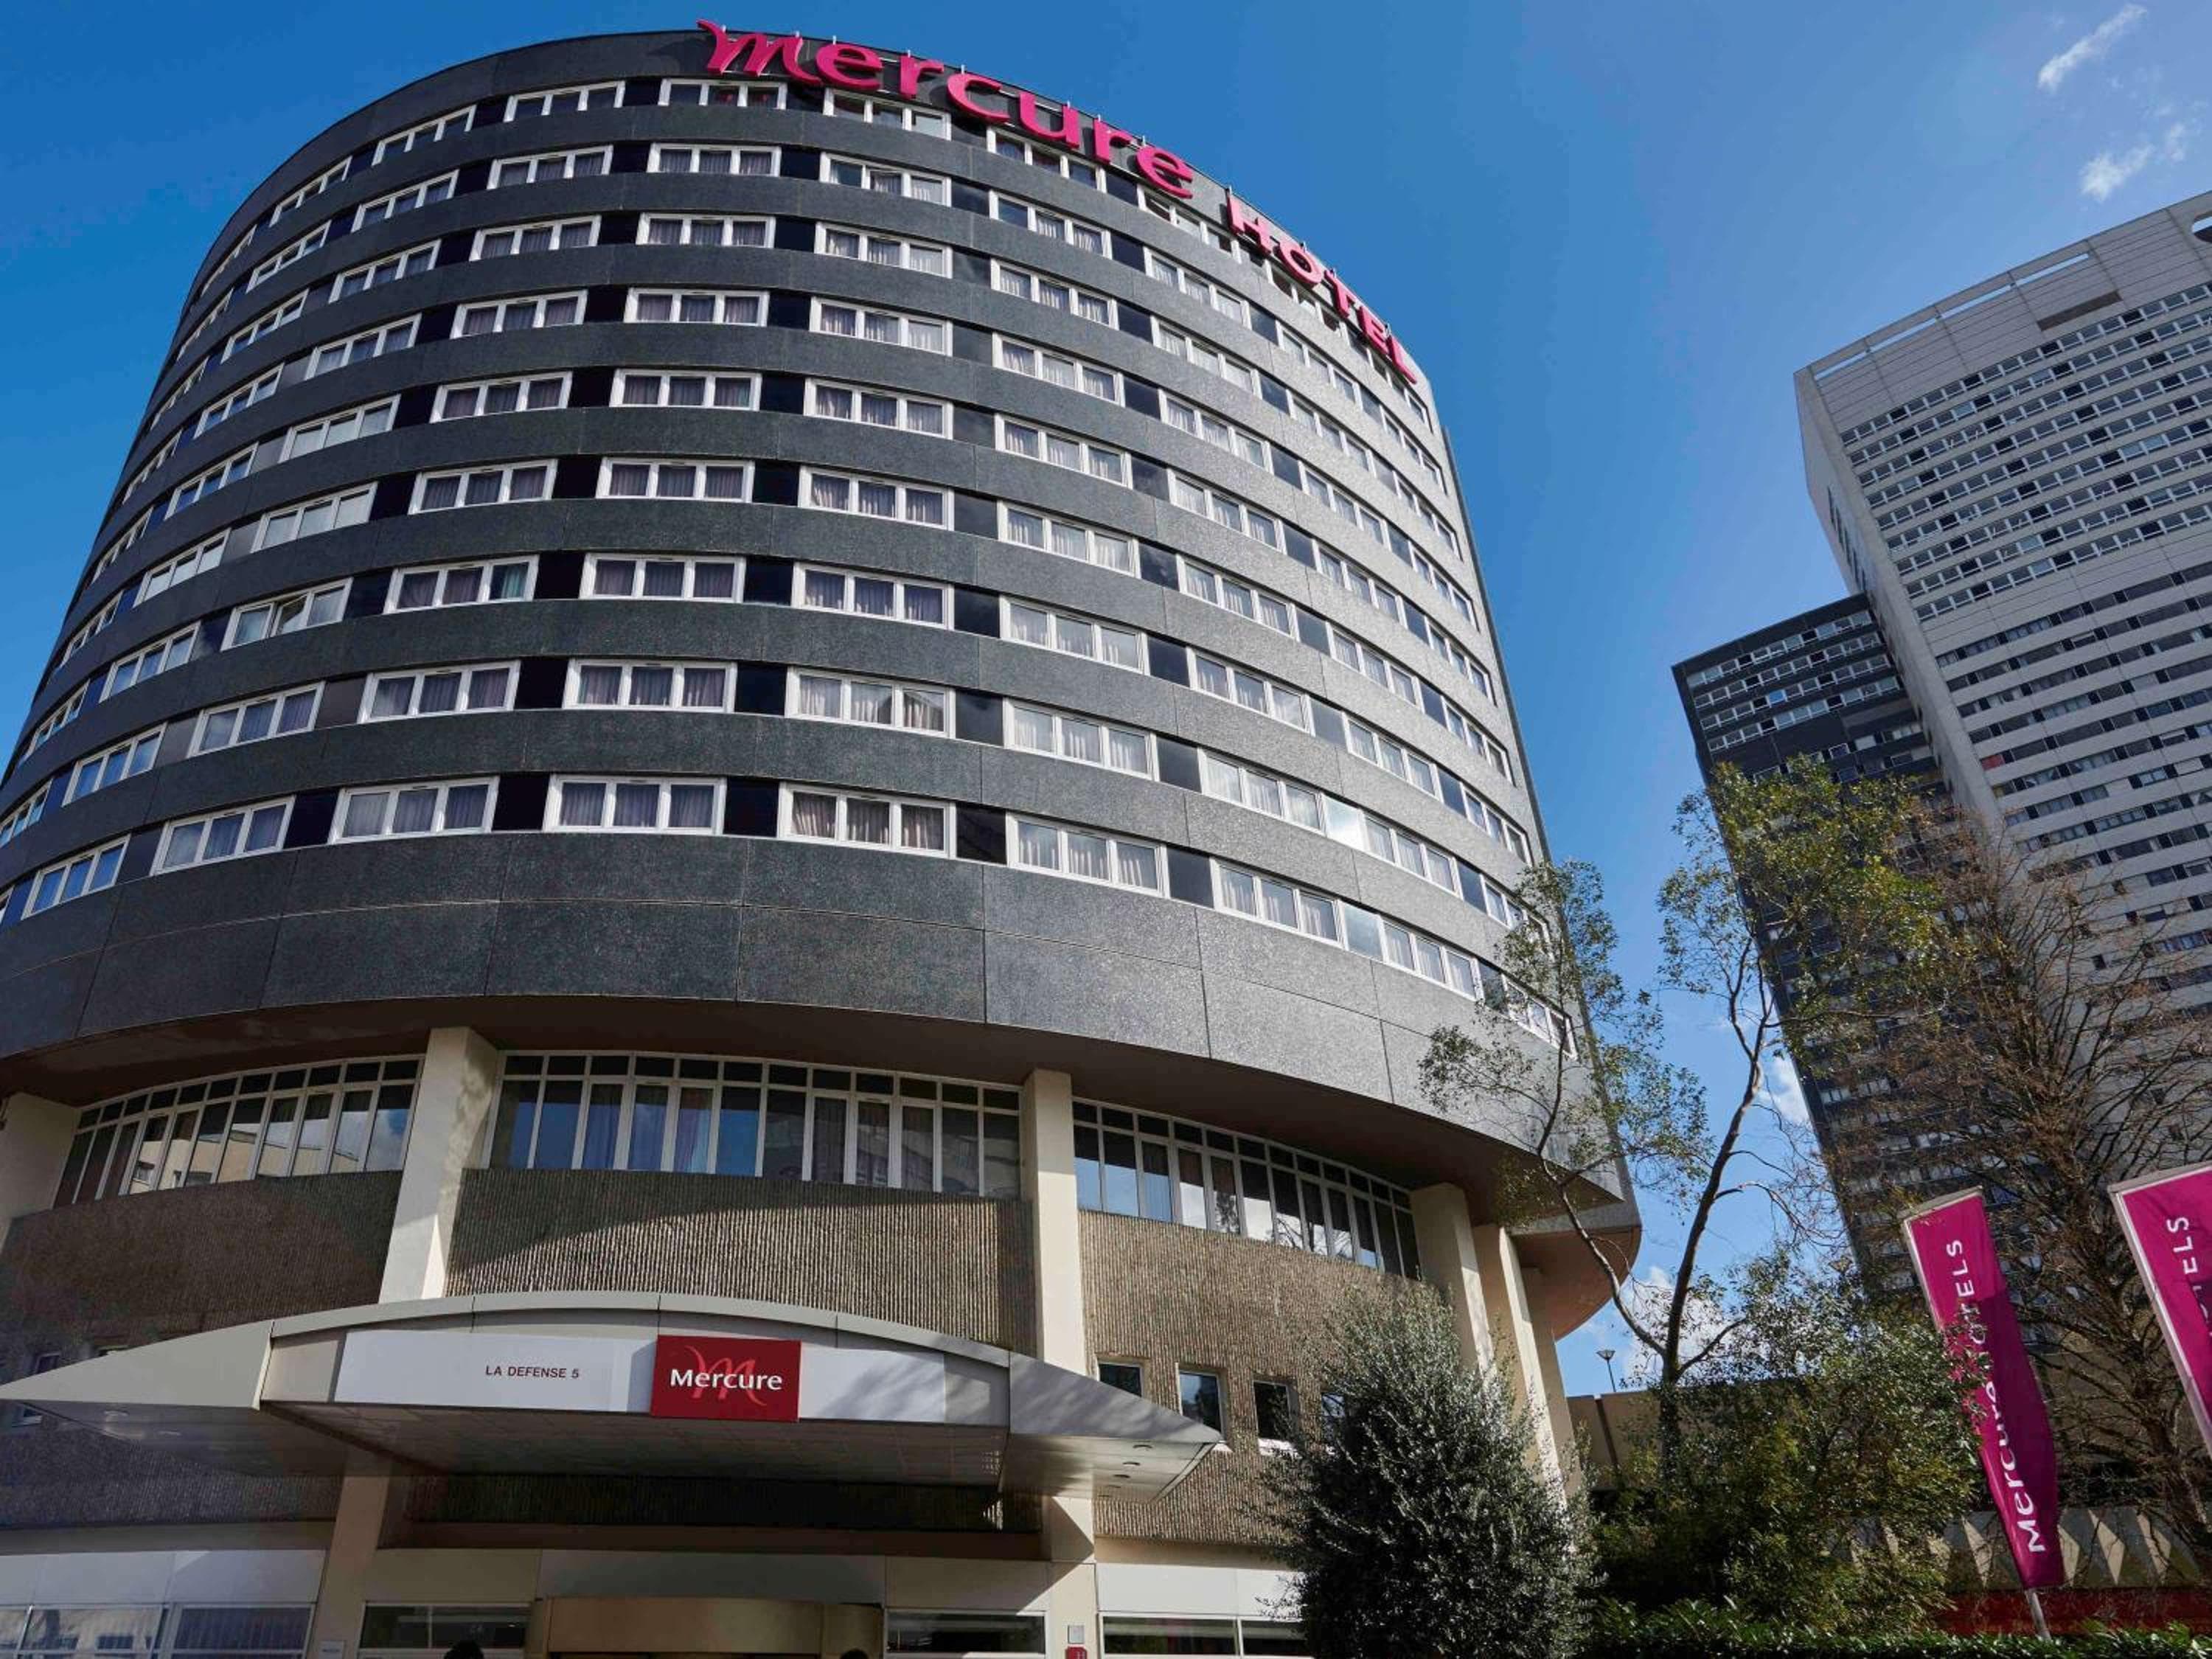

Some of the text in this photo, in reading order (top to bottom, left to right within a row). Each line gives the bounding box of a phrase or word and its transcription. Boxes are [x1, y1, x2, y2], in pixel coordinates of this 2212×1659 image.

[1226, 193, 1417, 385] HOTEL
[484, 1365, 579, 1379] LA DEFENSE 5
[669, 1368, 783, 1391] Mercure
